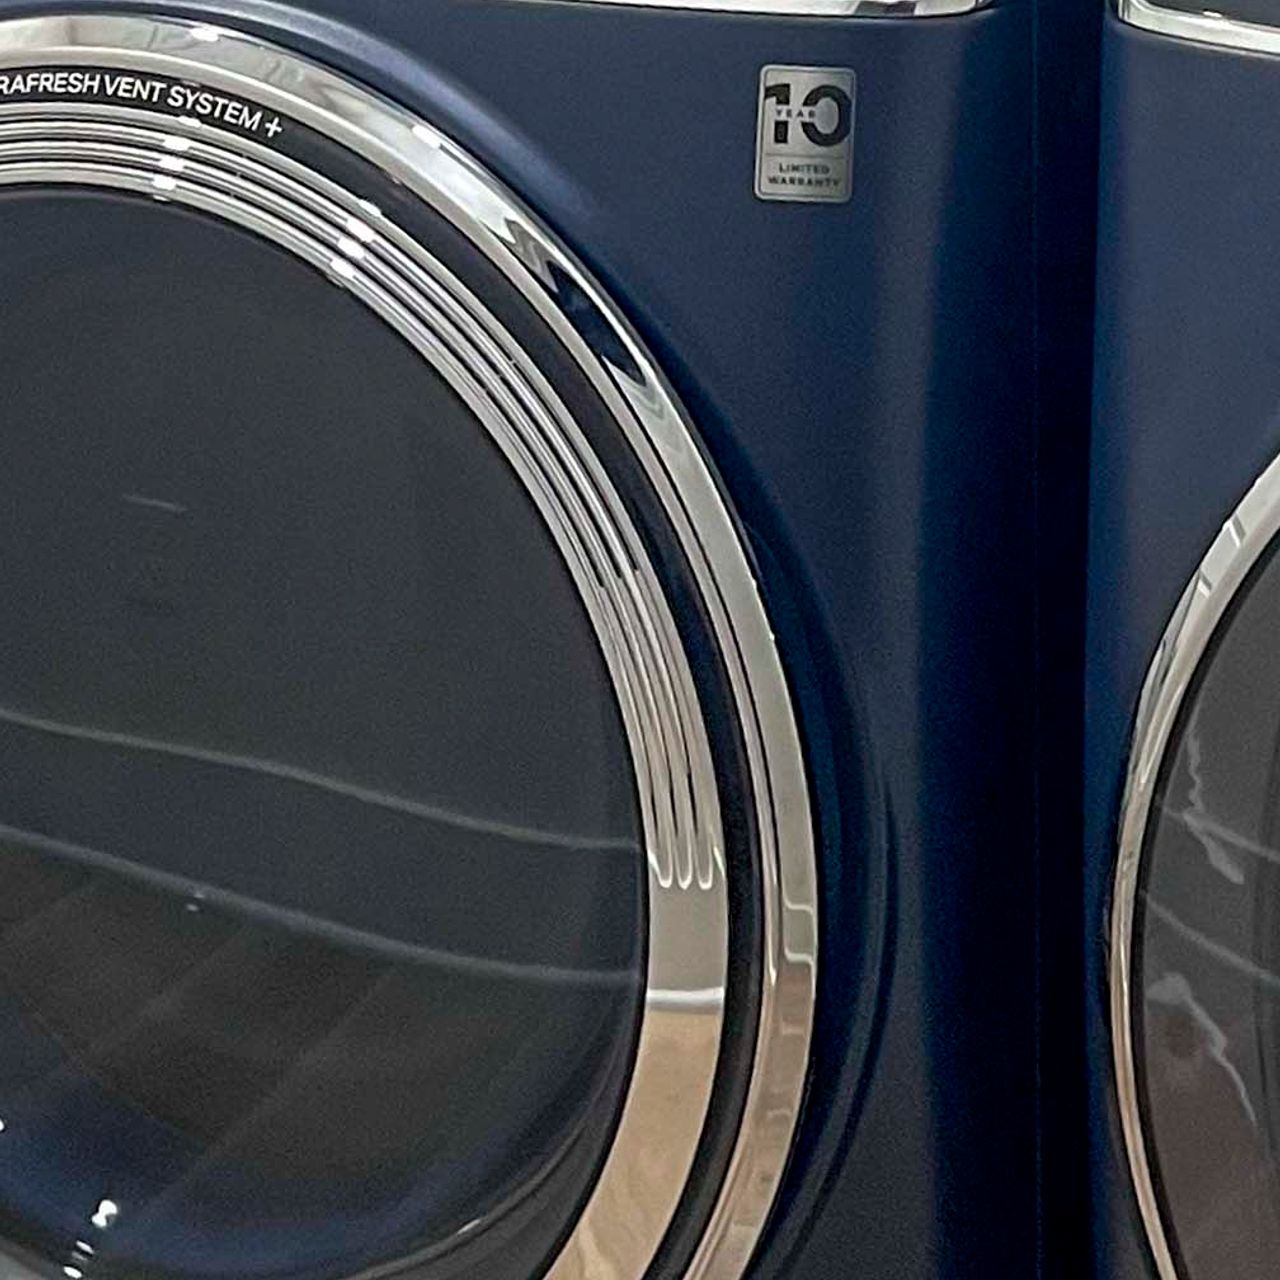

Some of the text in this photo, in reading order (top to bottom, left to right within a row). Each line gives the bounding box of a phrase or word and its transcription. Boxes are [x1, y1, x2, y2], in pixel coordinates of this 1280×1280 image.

[104, 72, 167, 103] VENT
[166, 85, 267, 131] SYSTEM
[264, 117, 283, 138] +
[765, 83, 852, 147] 10
[775, 108, 817, 119] YEAR
[779, 163, 831, 174] LIMITED
[767, 176, 841, 187] WARRANTY
